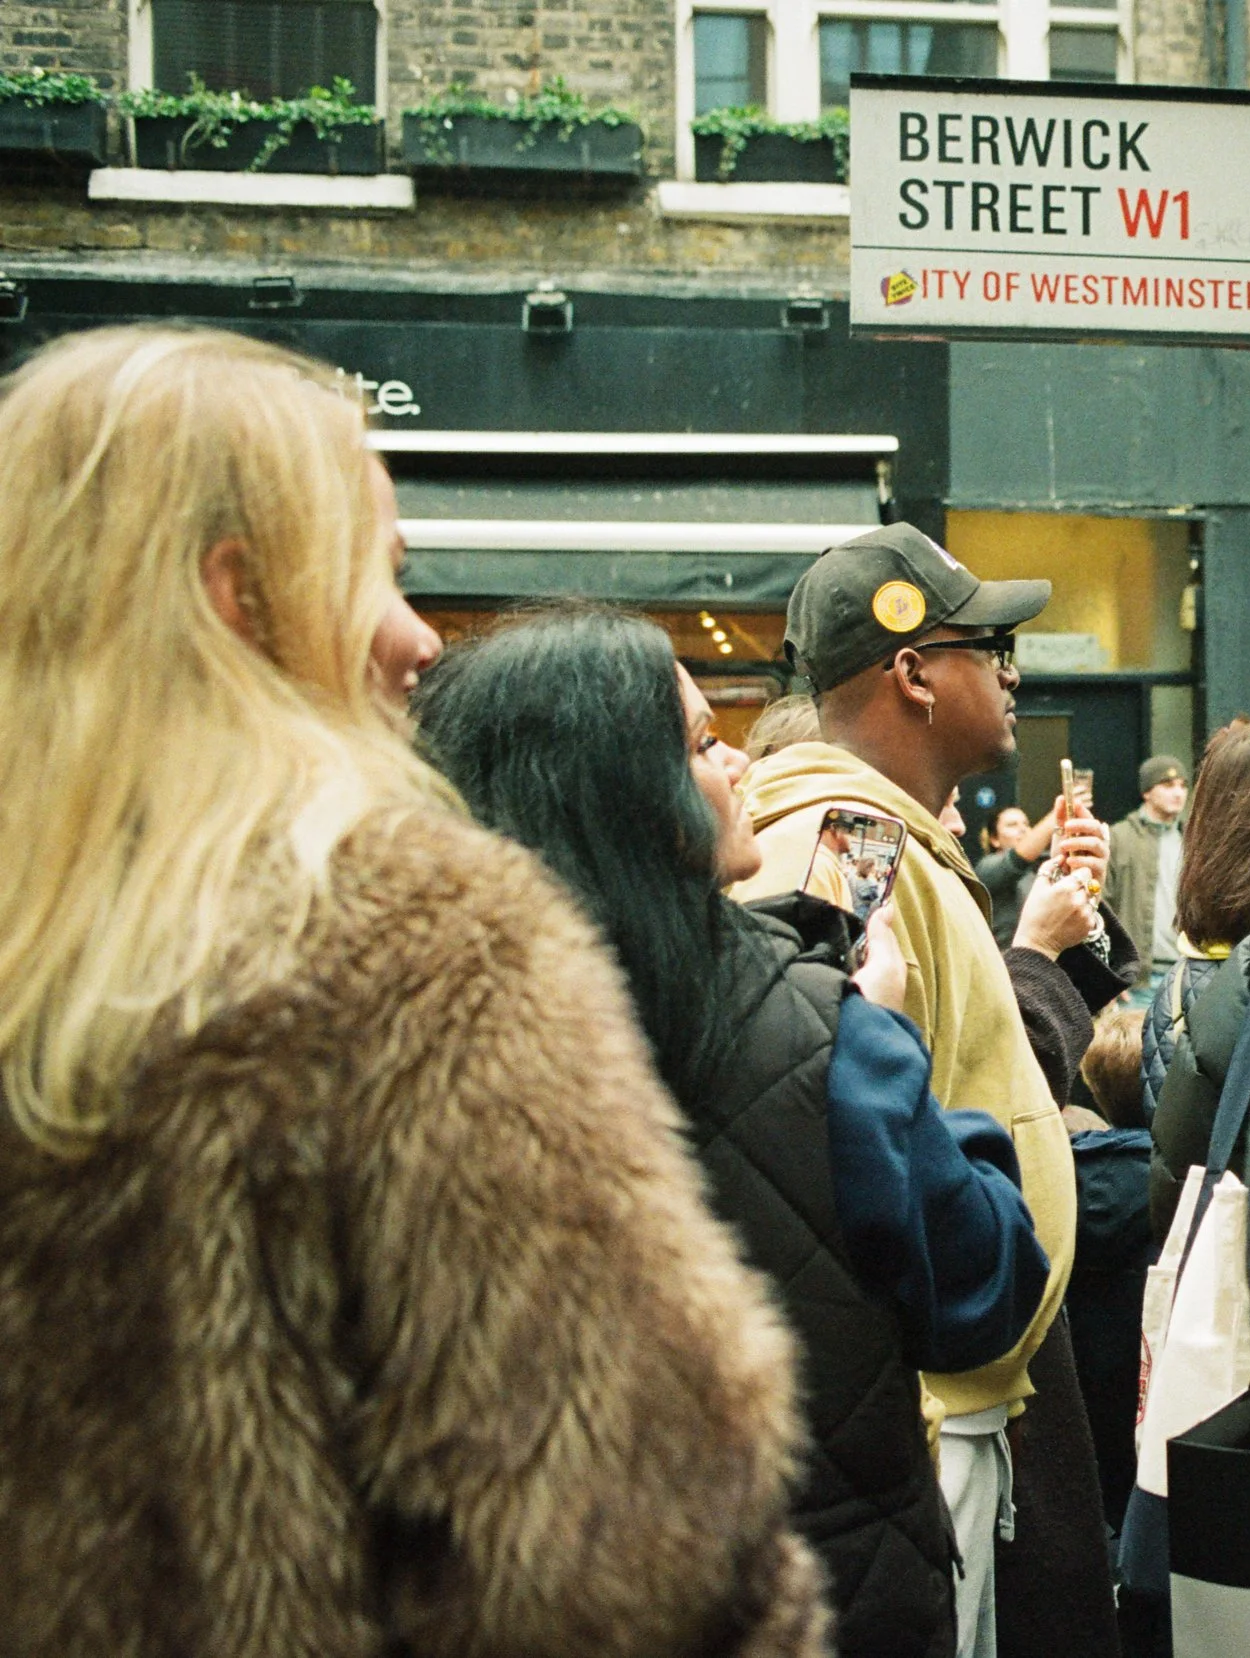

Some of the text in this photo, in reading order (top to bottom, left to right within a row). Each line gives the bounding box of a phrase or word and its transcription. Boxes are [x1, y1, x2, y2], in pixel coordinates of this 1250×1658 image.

[899, 111, 1152, 172] BERWICK
[898, 178, 1101, 236] STREET
[1117, 187, 1190, 240] W1
[900, 268, 972, 301] ITY
[982, 270, 1021, 302] OF
